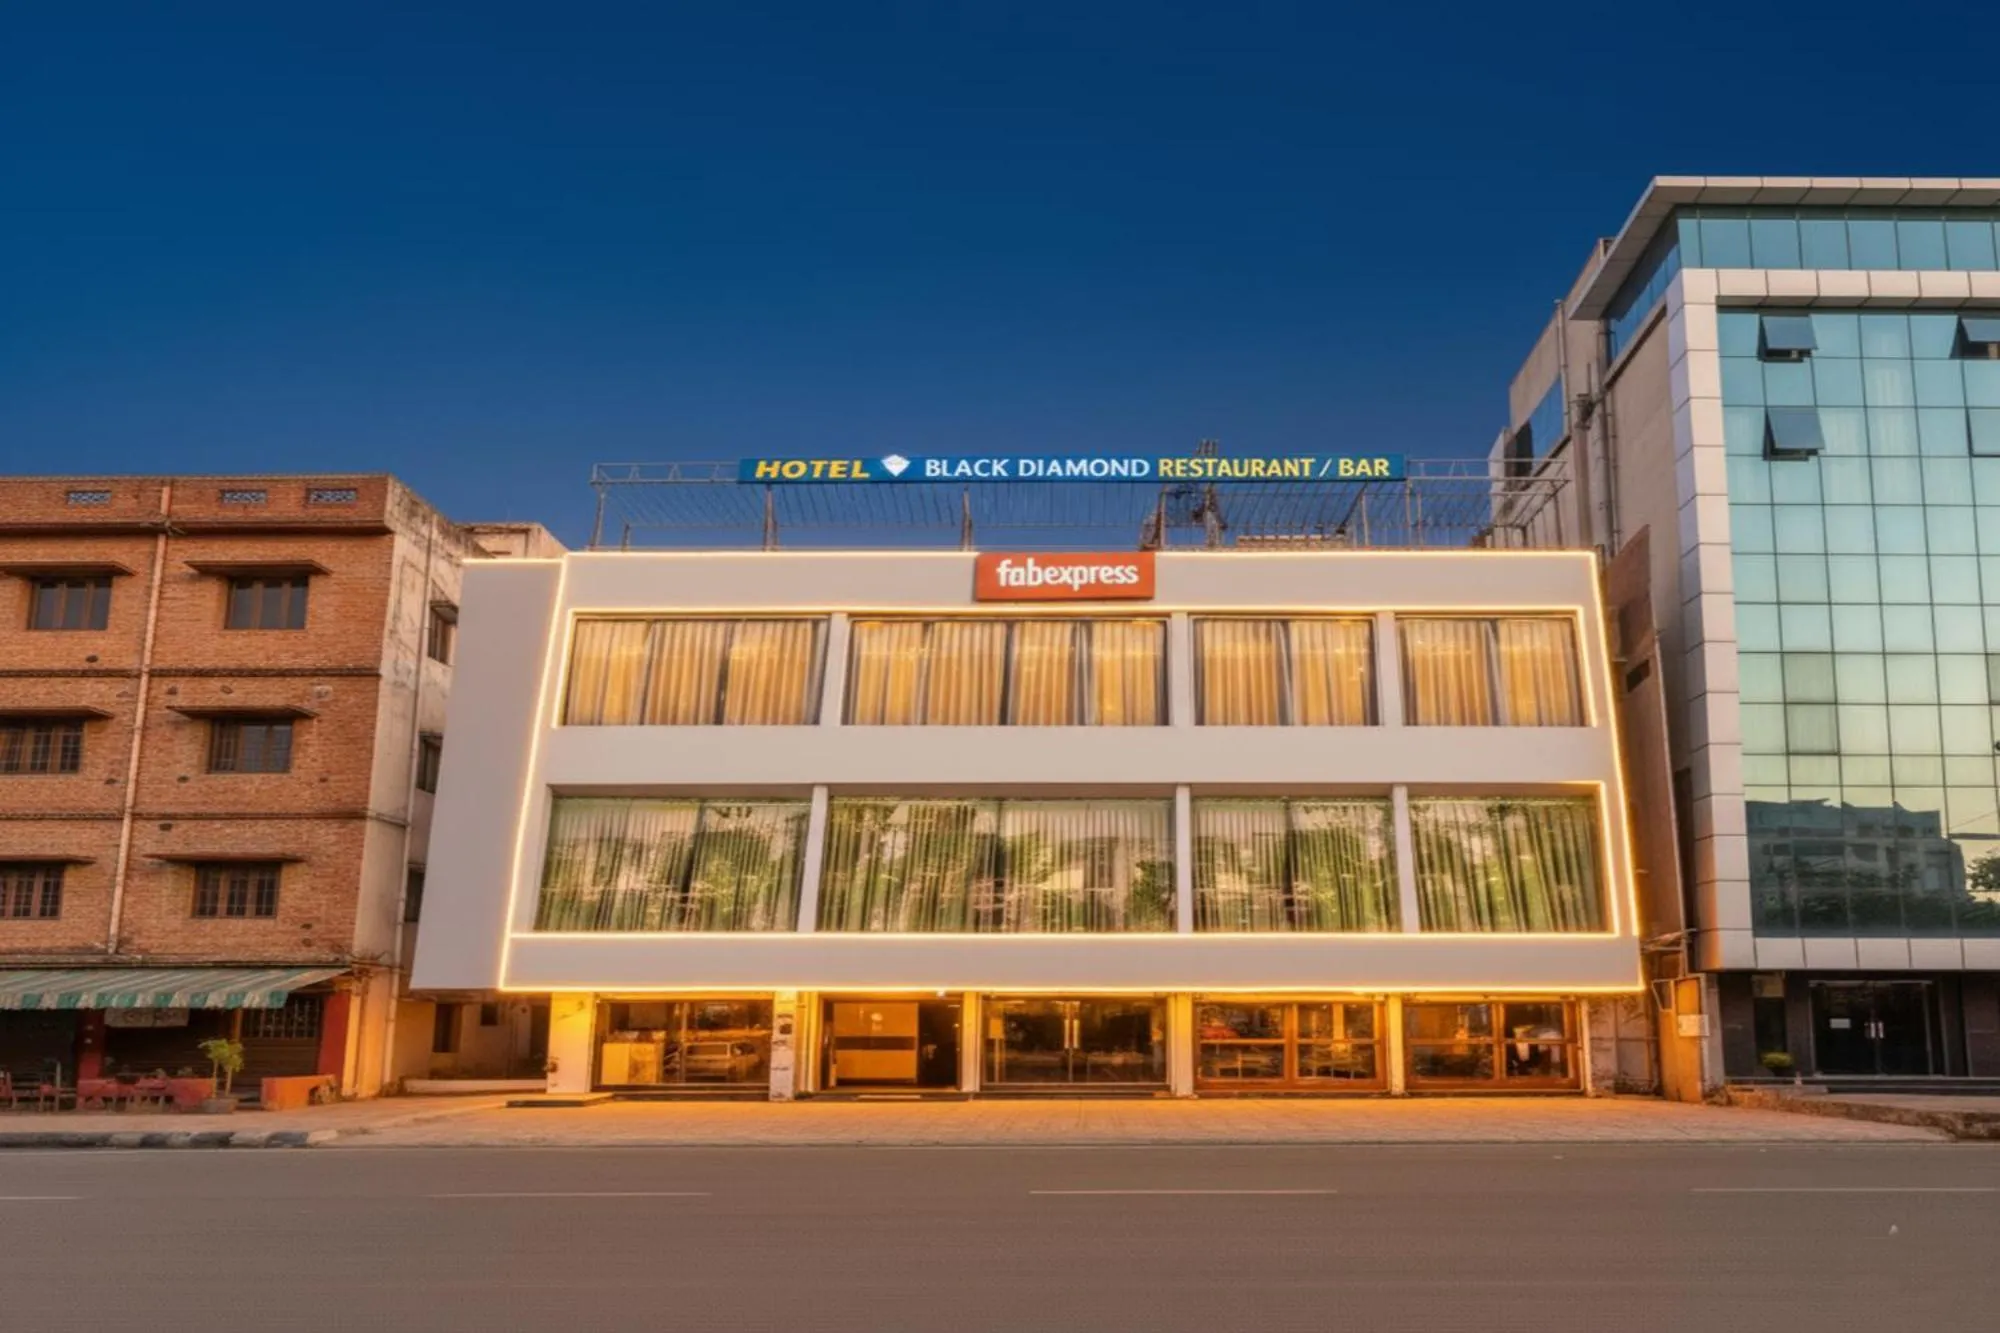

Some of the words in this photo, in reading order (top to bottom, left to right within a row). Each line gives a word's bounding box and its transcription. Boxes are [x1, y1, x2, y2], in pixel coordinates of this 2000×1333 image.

[755, 460, 870, 479] HOTEL
[925, 459, 1009, 477] BLACK
[1018, 459, 1150, 477] DIAMOND
[1158, 459, 1315, 477] RESTAURANT
[1318, 458, 1332, 477] /
[1338, 458, 1390, 477] BAR
[997, 557, 1139, 591] fabexpress
